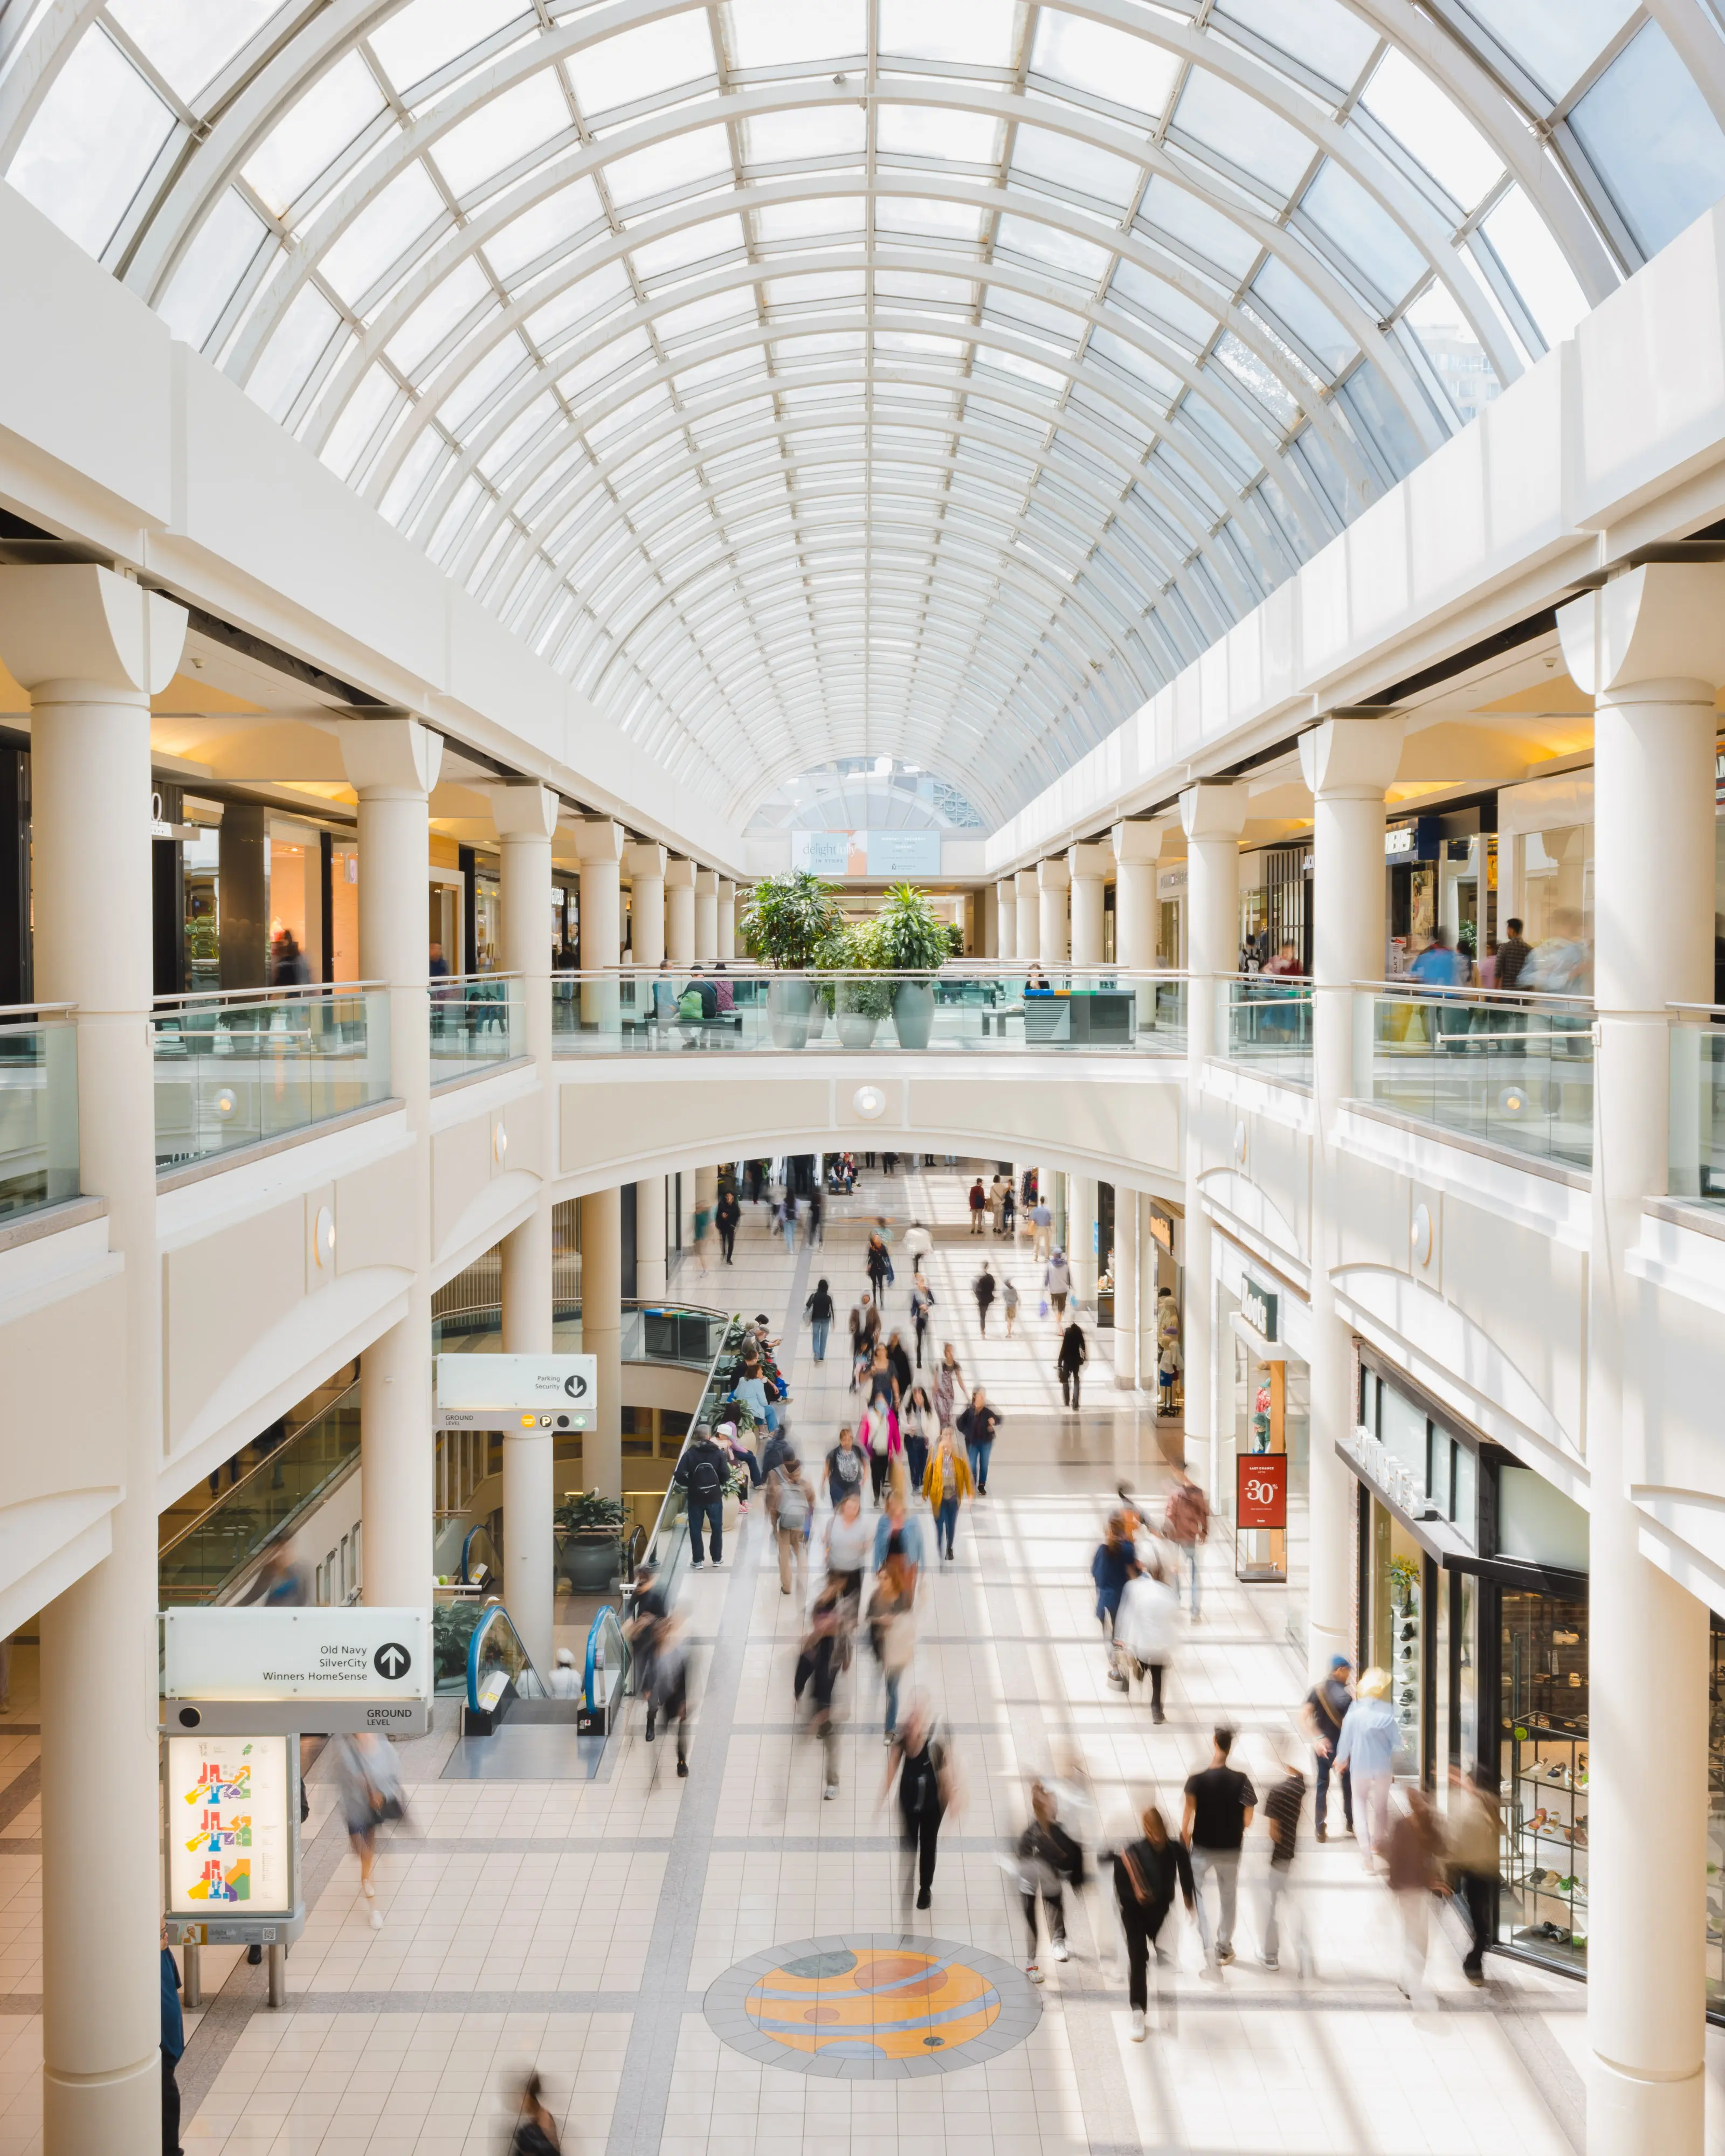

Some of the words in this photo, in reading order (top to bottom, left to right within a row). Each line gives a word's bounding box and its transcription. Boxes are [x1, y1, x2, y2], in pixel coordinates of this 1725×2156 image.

[803, 842, 856, 857] delightfully
[321, 1646, 338, 1654] Old
[342, 1646, 367, 1656] Navy
[320, 1659, 367, 1669] SilverCity
[263, 1672, 305, 1681] Winners
[308, 1672, 368, 1681] HomeSense
[367, 1709, 412, 1718] GROUND
